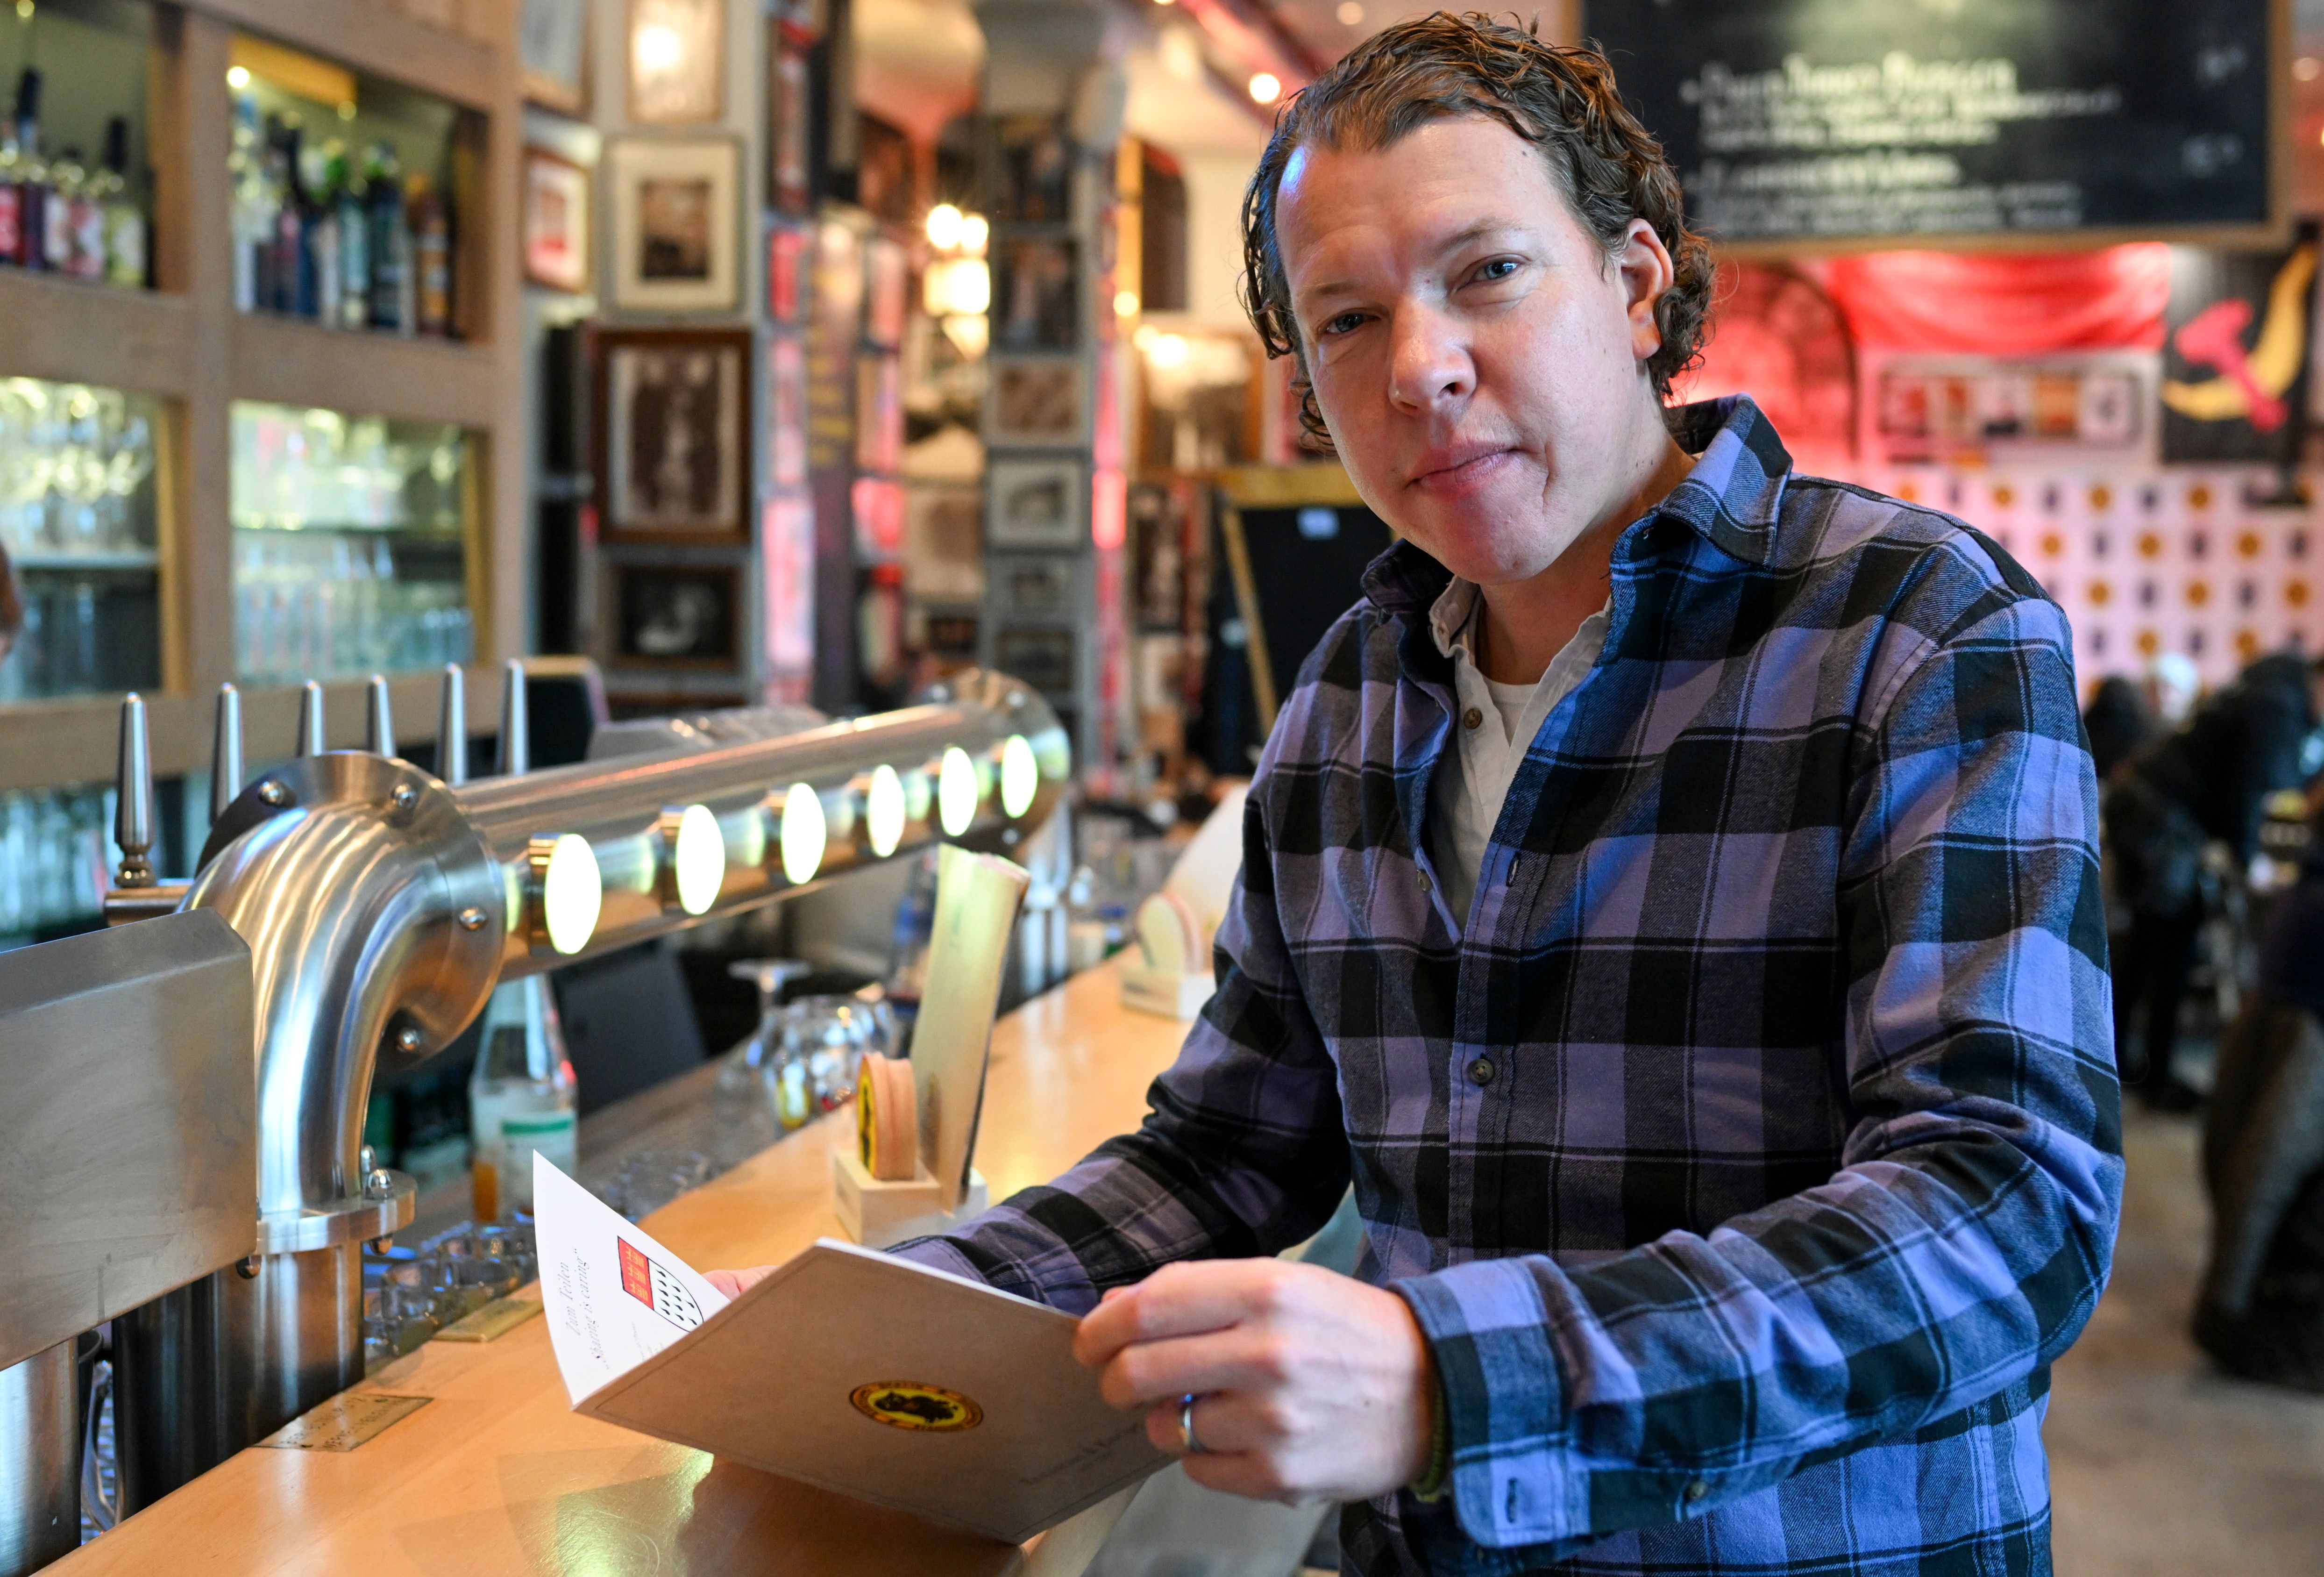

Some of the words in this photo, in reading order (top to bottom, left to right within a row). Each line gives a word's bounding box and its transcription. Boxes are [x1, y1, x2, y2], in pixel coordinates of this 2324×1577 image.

[557, 1262, 573, 1300] Teilen
[566, 1306, 581, 1336] Zum
[579, 1301, 592, 1313] is
